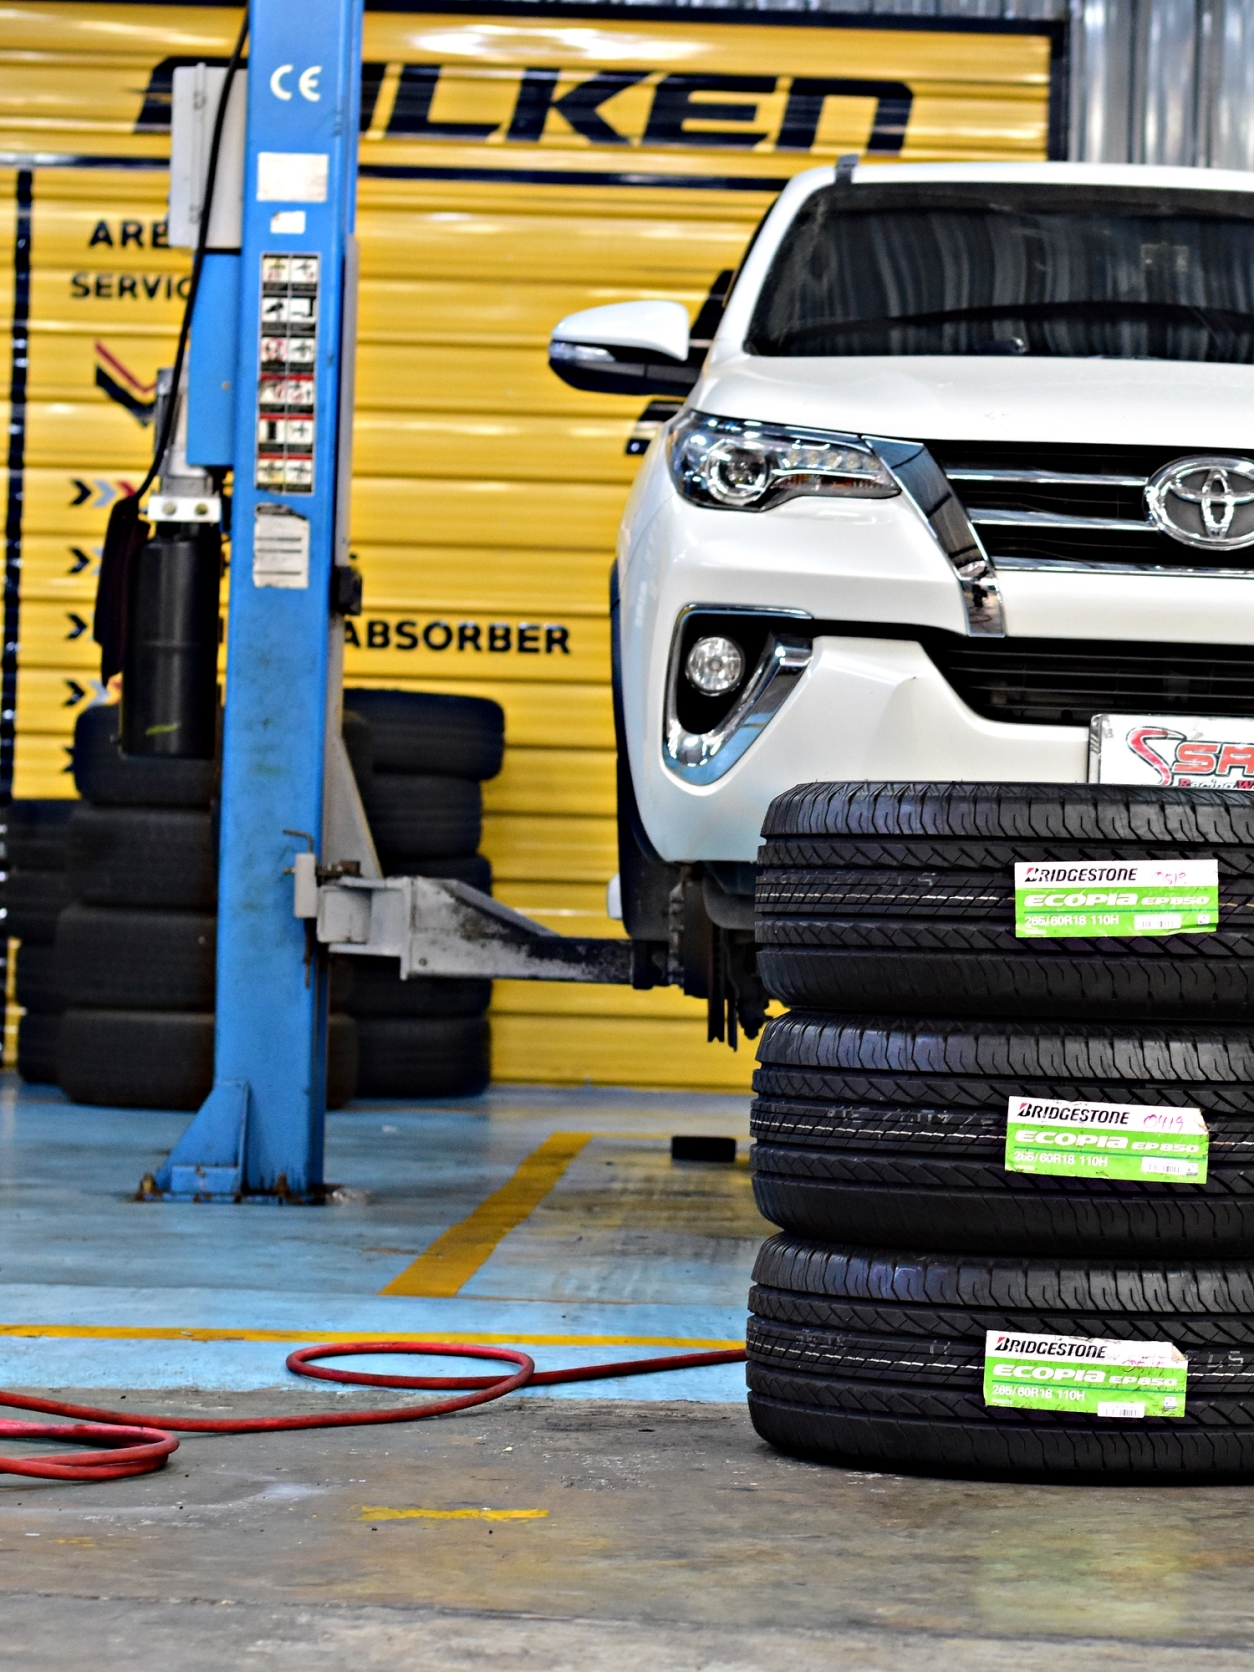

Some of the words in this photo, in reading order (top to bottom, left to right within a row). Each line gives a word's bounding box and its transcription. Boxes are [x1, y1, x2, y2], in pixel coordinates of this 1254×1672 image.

[269, 64, 322, 102] CE
[89, 219, 170, 248] ARE
[71, 272, 191, 299] SERVIC
[344, 619, 571, 655] ABSORBER
[1024, 867, 1138, 883] BRIDGESTONE
[1141, 896, 1210, 906] EP850
[1091, 915, 1120, 926] 110H
[1017, 1102, 1130, 1125] BRIDGESTONE
[1131, 1141, 1199, 1153] EP850
[1080, 1155, 1109, 1167] 110H
[994, 1336, 1107, 1359] BRIDGESTONE
[1109, 1375, 1177, 1387] EP850
[1057, 1389, 1085, 1401] 110H
